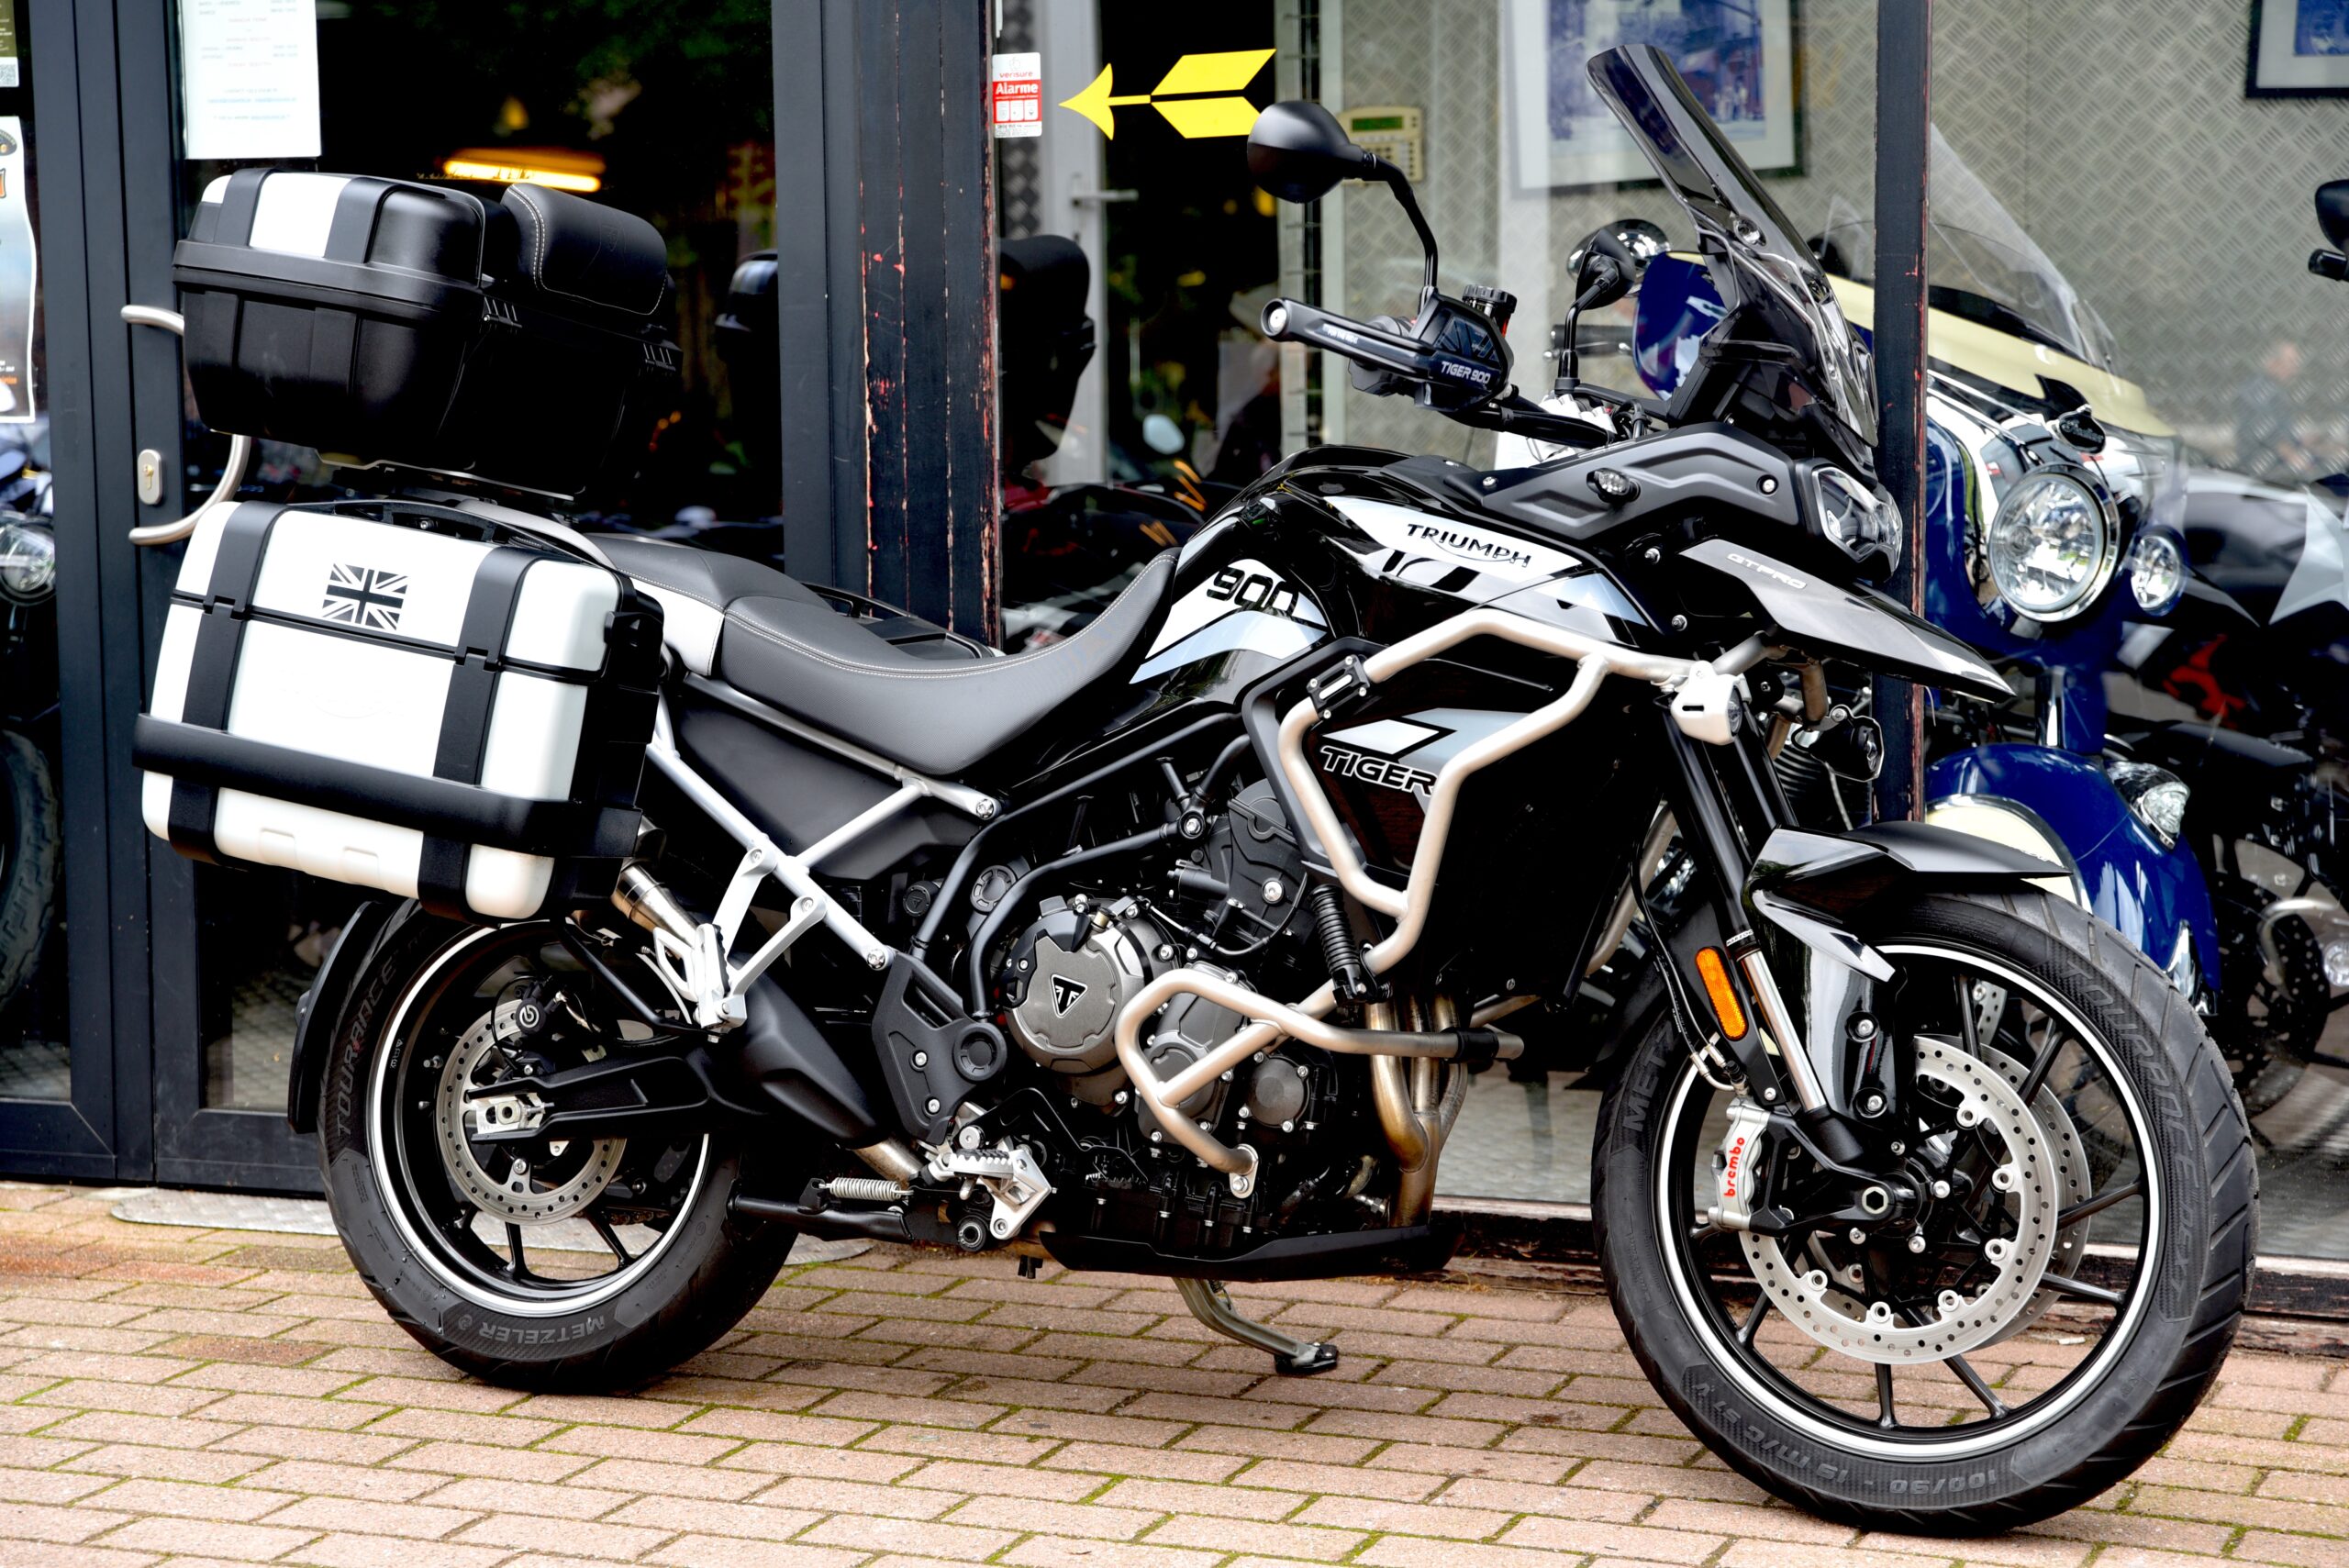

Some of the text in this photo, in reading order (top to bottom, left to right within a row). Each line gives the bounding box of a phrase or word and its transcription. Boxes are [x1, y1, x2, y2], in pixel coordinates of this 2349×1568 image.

[996, 83, 1039, 95] Alarme
[1441, 361, 1491, 384] TIGER 900
[1407, 523, 1531, 568] TRIUMPH
[1206, 566, 1299, 620] 900
[1319, 745, 1438, 797] TIGER
[337, 955, 397, 1138] TOURANCE
[2060, 959, 2200, 1189] TOURANCE
[1724, 1137, 1745, 1197] brembo
[478, 1315, 606, 1345] METZELER
[1816, 1462, 1849, 1484] 19
[1889, 1468, 1997, 1496] 100/90
